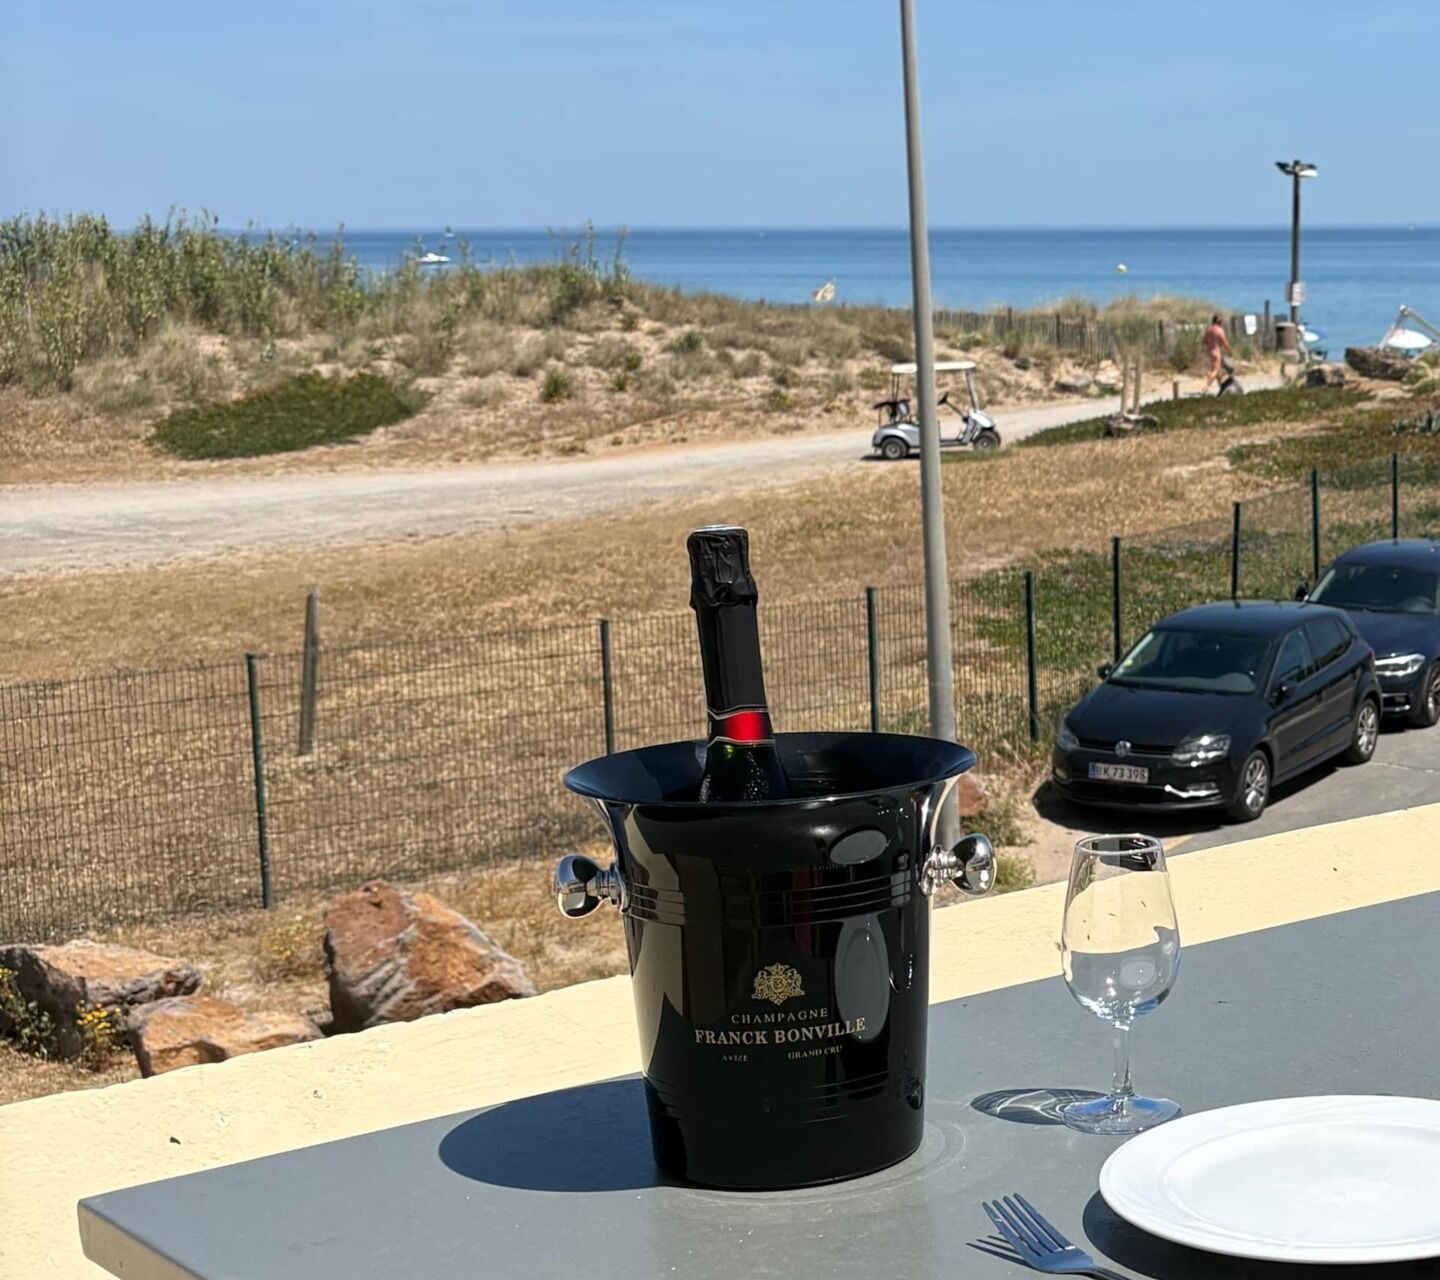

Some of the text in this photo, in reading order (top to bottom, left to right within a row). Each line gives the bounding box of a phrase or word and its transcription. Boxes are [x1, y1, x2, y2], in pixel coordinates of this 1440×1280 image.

[731, 1007, 829, 1024] CHAMPAGNE
[695, 1017, 866, 1045] FRANCK BONVILLE
[787, 1045, 843, 1060] GRAND CRU
